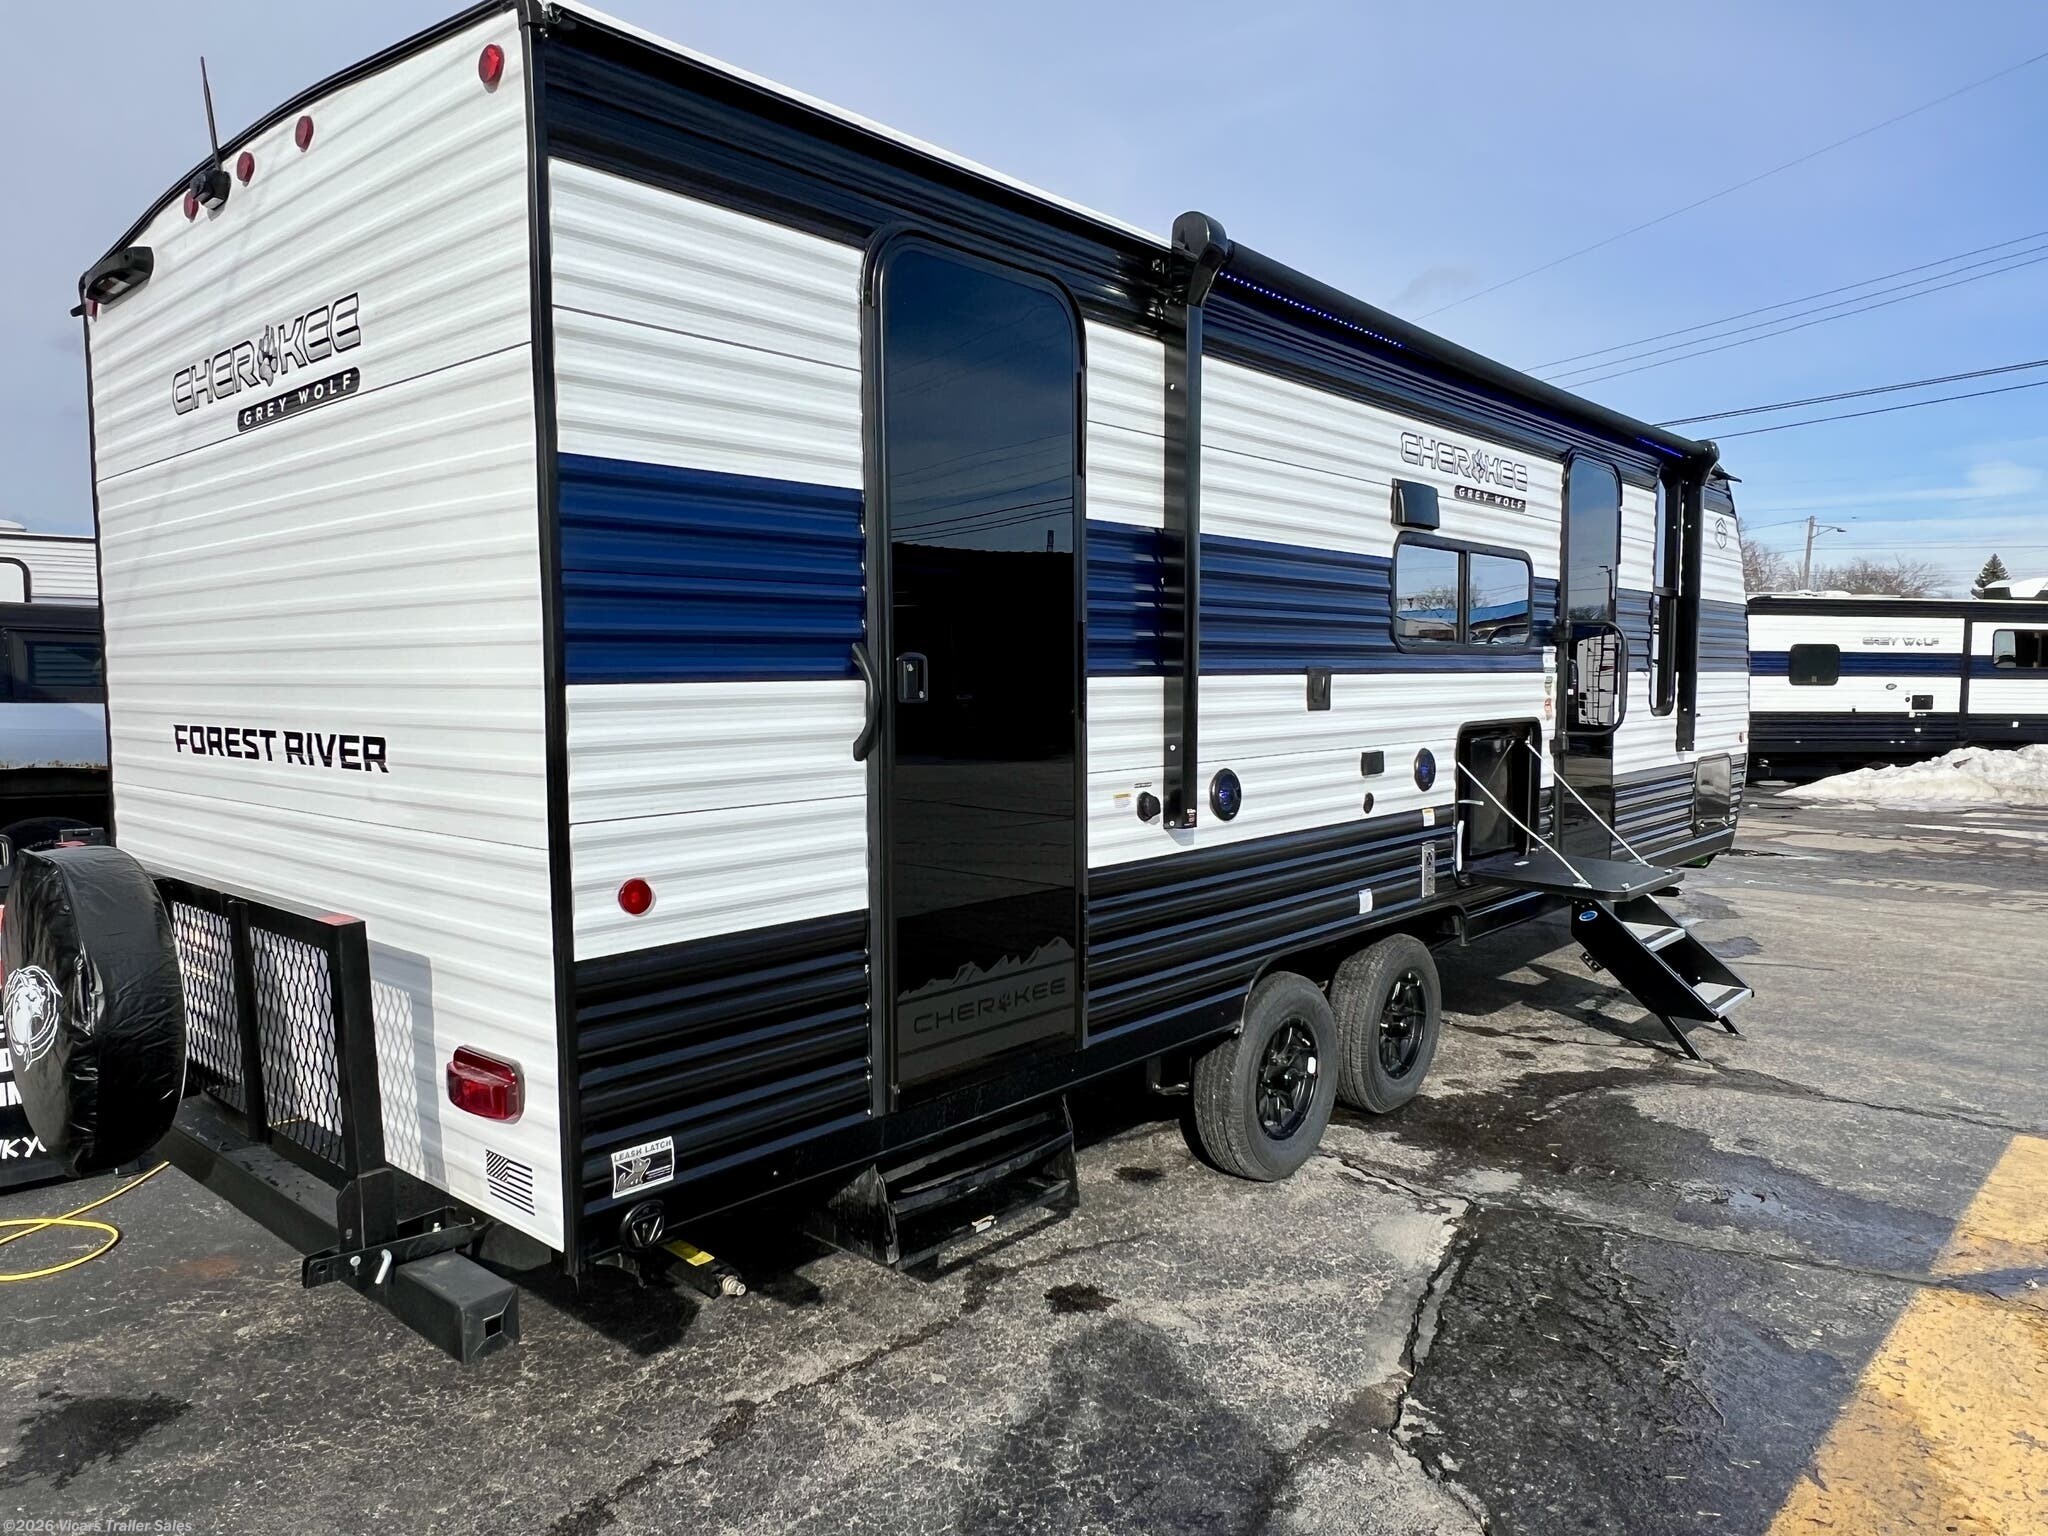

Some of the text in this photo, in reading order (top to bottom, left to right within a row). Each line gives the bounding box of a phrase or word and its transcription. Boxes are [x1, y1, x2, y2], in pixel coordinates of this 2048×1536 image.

[243, 373, 352, 425] GREY WOLF
[1458, 487, 1524, 510] GREY WOLF
[1862, 636, 1897, 646] GREY
[173, 724, 389, 773] FOREST RIVER
[613, 1139, 673, 1162] LEASH LATCH
